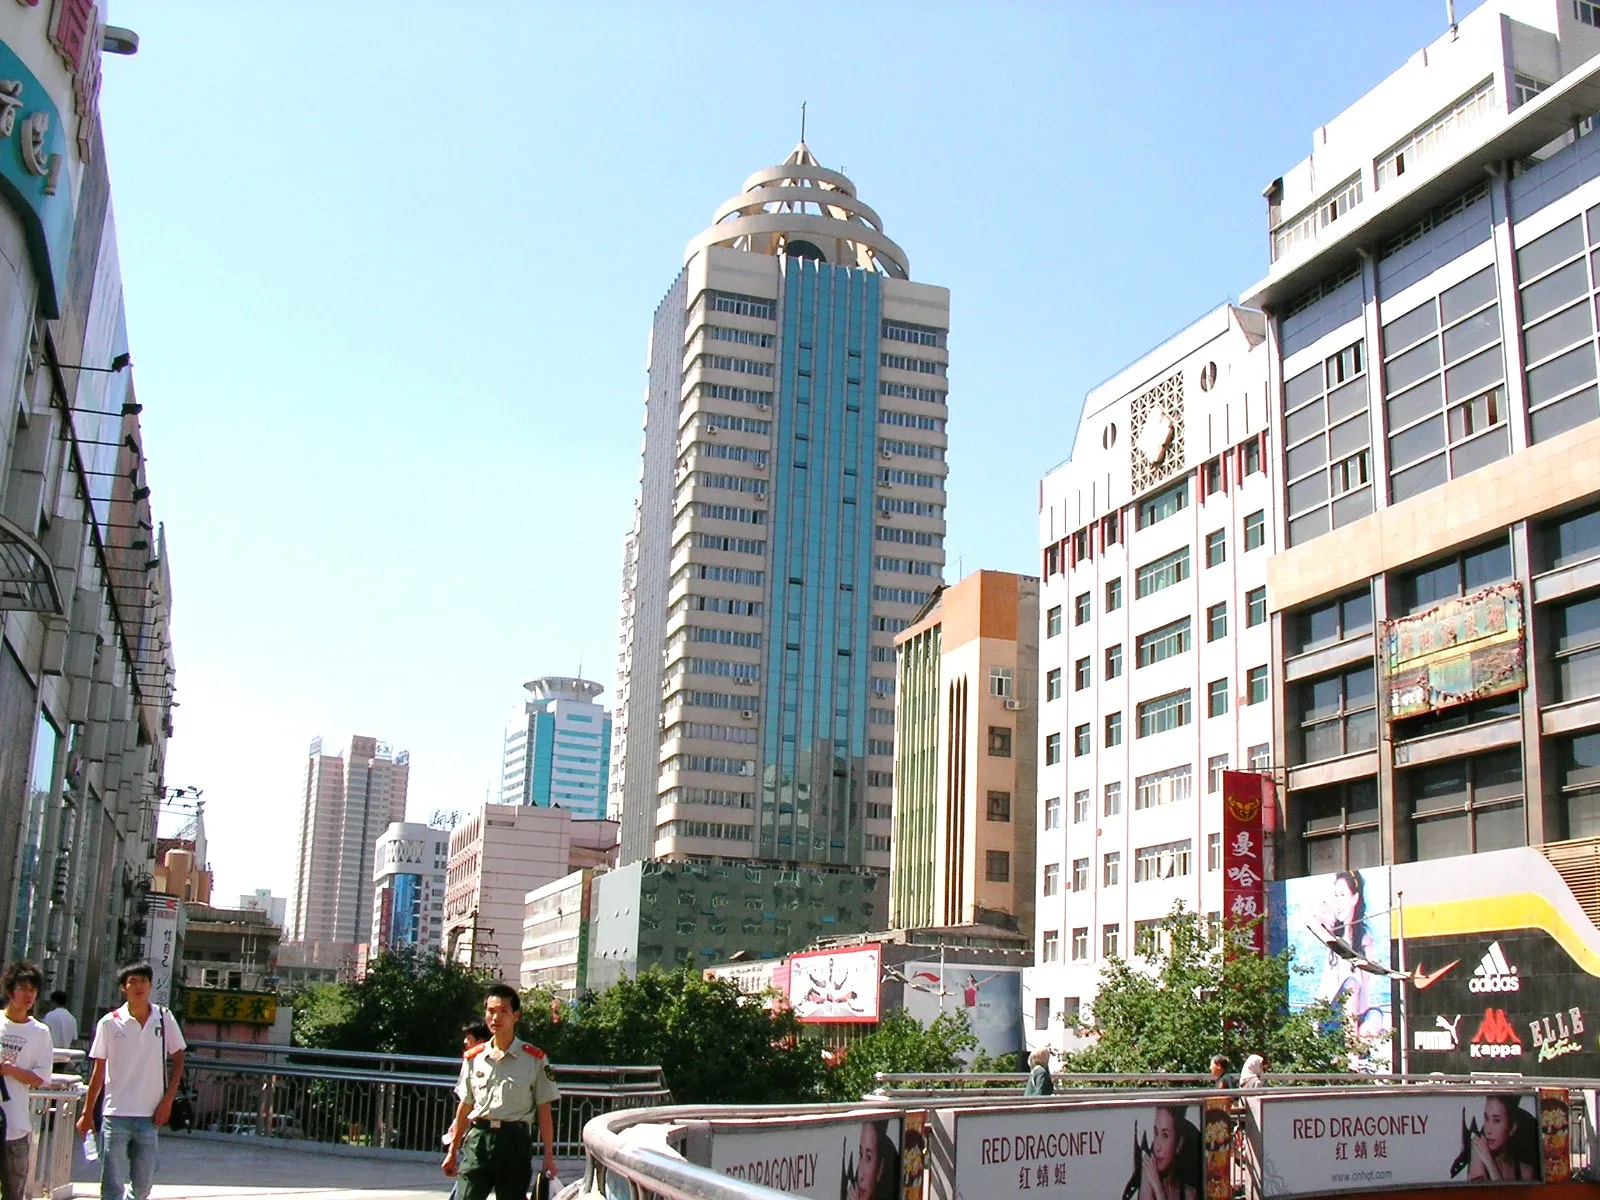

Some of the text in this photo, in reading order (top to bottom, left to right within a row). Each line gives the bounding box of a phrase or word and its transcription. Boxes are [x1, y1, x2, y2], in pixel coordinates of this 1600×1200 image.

[1468, 974, 1520, 993] adidas
[1529, 1007, 1584, 1047] ELLE
[1414, 1031, 1456, 1050] PUMA
[1470, 1043, 1522, 1058] Kappa
[1538, 1037, 1583, 1062] Active
[1293, 1114, 1428, 1139] RED DRAGONFLY
[981, 1130, 1105, 1165] RED DRAGONFLY
[1335, 1140, 1387, 1160] 红蜻蜓
[1019, 1163, 1067, 1190] 红蜻蜓
